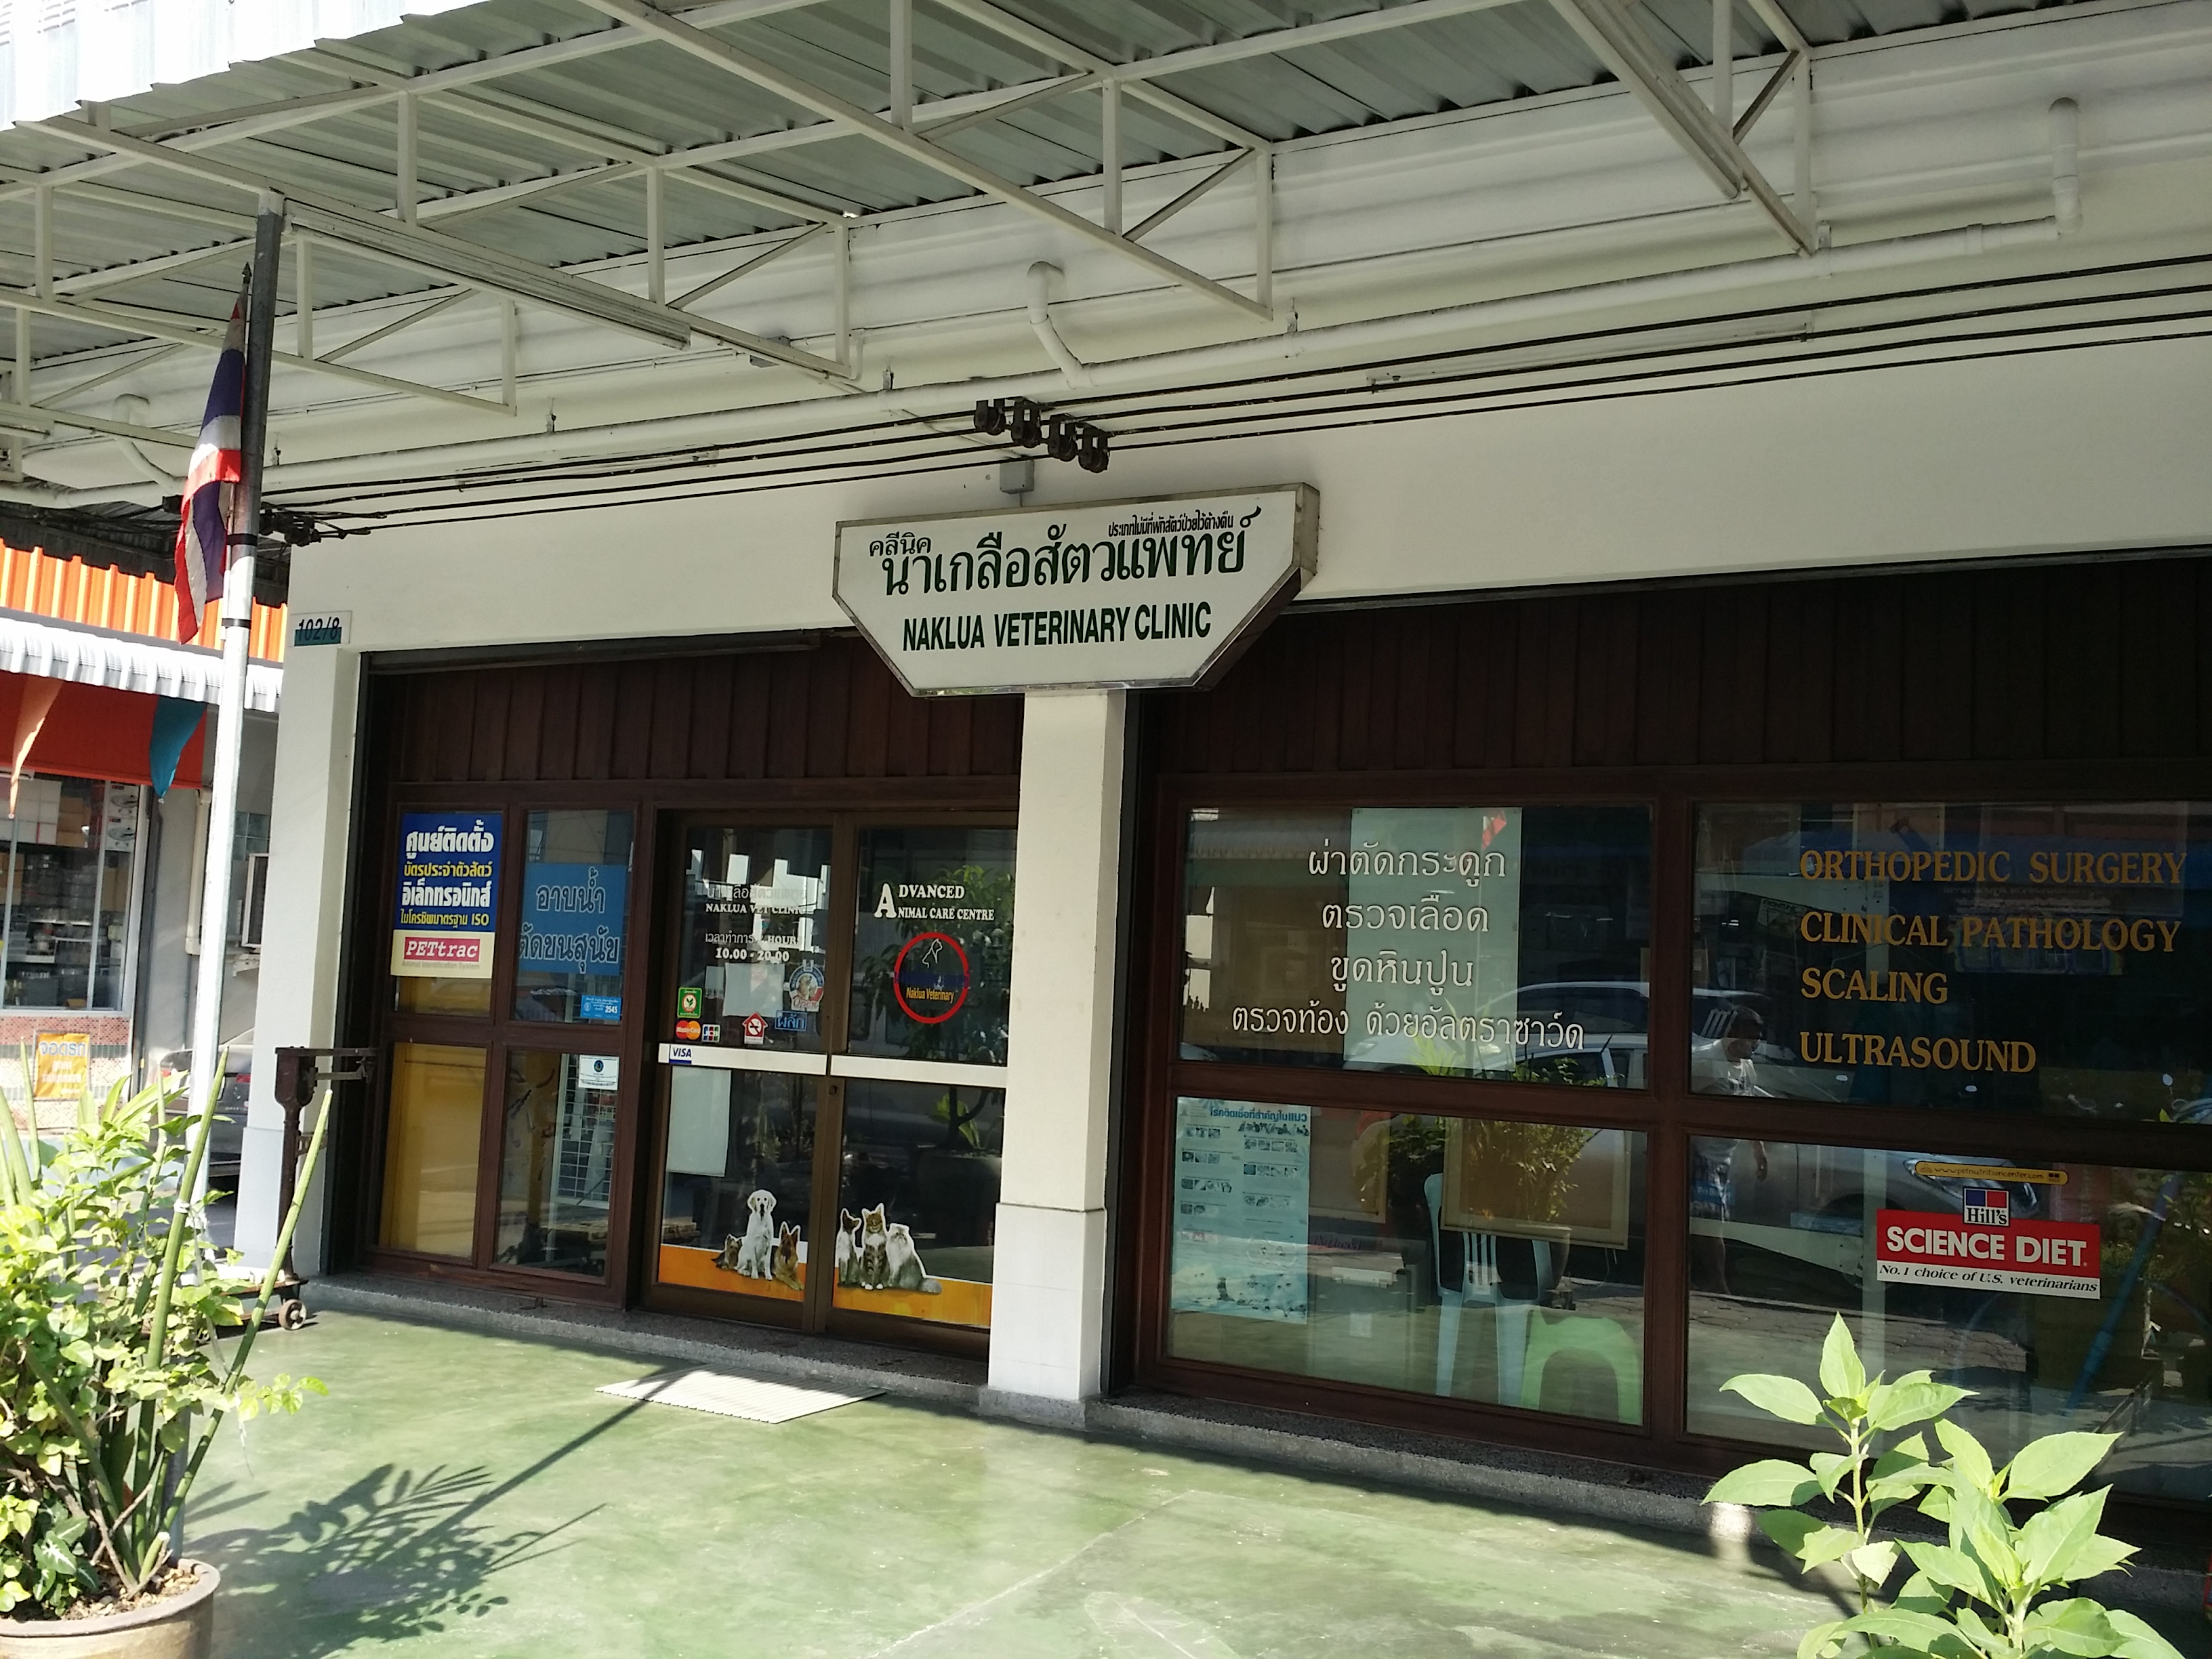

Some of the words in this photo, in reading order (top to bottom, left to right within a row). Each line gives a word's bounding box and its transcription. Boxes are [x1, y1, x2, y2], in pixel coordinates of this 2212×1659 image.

[869, 531, 932, 557] คลีนิค
[881, 506, 1262, 596] นาเกลือสัตวแพทย์
[298, 616, 340, 642] 102/8
[902, 614, 985, 651] NAKLUA
[994, 605, 1130, 647] VETERINARY
[1134, 601, 1212, 639] CLINIC
[405, 819, 495, 859] ศูนย์ติดตั้ง
[403, 861, 493, 878] บัตรประจำตัวสัตว์
[1308, 838, 1506, 888] ผ่าตัดกระดูก
[1800, 850, 2011, 882] ORTHOPEDIC
[2029, 851, 2187, 884] SURGERY
[401, 878, 493, 908] อิเล็กทรอนิกส์
[535, 866, 607, 914] อาบน้ำ
[471, 913, 489, 926] ISO
[705, 903, 747, 913] NAKLUA
[749, 904, 770, 914] VET
[929, 907, 956, 920] CARE
[956, 908, 995, 921] CENTRE
[1322, 893, 1490, 933] ตรวจเลือด
[705, 930, 754, 943] เวลาทำการ
[1800, 911, 1948, 947] CLINICAL
[1962, 916, 2180, 953] PATHOLOGY
[405, 940, 478, 958] PETtrac
[520, 922, 620, 975] ตัดขนสุนัข
[715, 947, 747, 960] 10.00
[1331, 949, 1474, 996] ขูดหินปูน
[1801, 966, 1948, 1004] SCALING
[605, 1005, 617, 1014] 2545
[905, 987, 926, 1000] Naklua
[926, 988, 955, 1004] Veterinary
[777, 1013, 805, 1029] ผลัก
[1232, 1000, 1349, 1036] ตรวจท้อง
[673, 1048, 692, 1057] VISA
[1799, 1031, 2036, 1073] ULTRASOUND
[1966, 1207, 2007, 1225] Hill's
[1886, 1226, 2005, 1261] SCIENCE
[2015, 1235, 2087, 1267] DIET
[1879, 1264, 1901, 1275] No.
[1914, 1267, 1958, 1280] choice
[1961, 1273, 1977, 1282] of
[1979, 1273, 2004, 1285] U.S.
[2009, 1276, 2097, 1293] veterinarians
